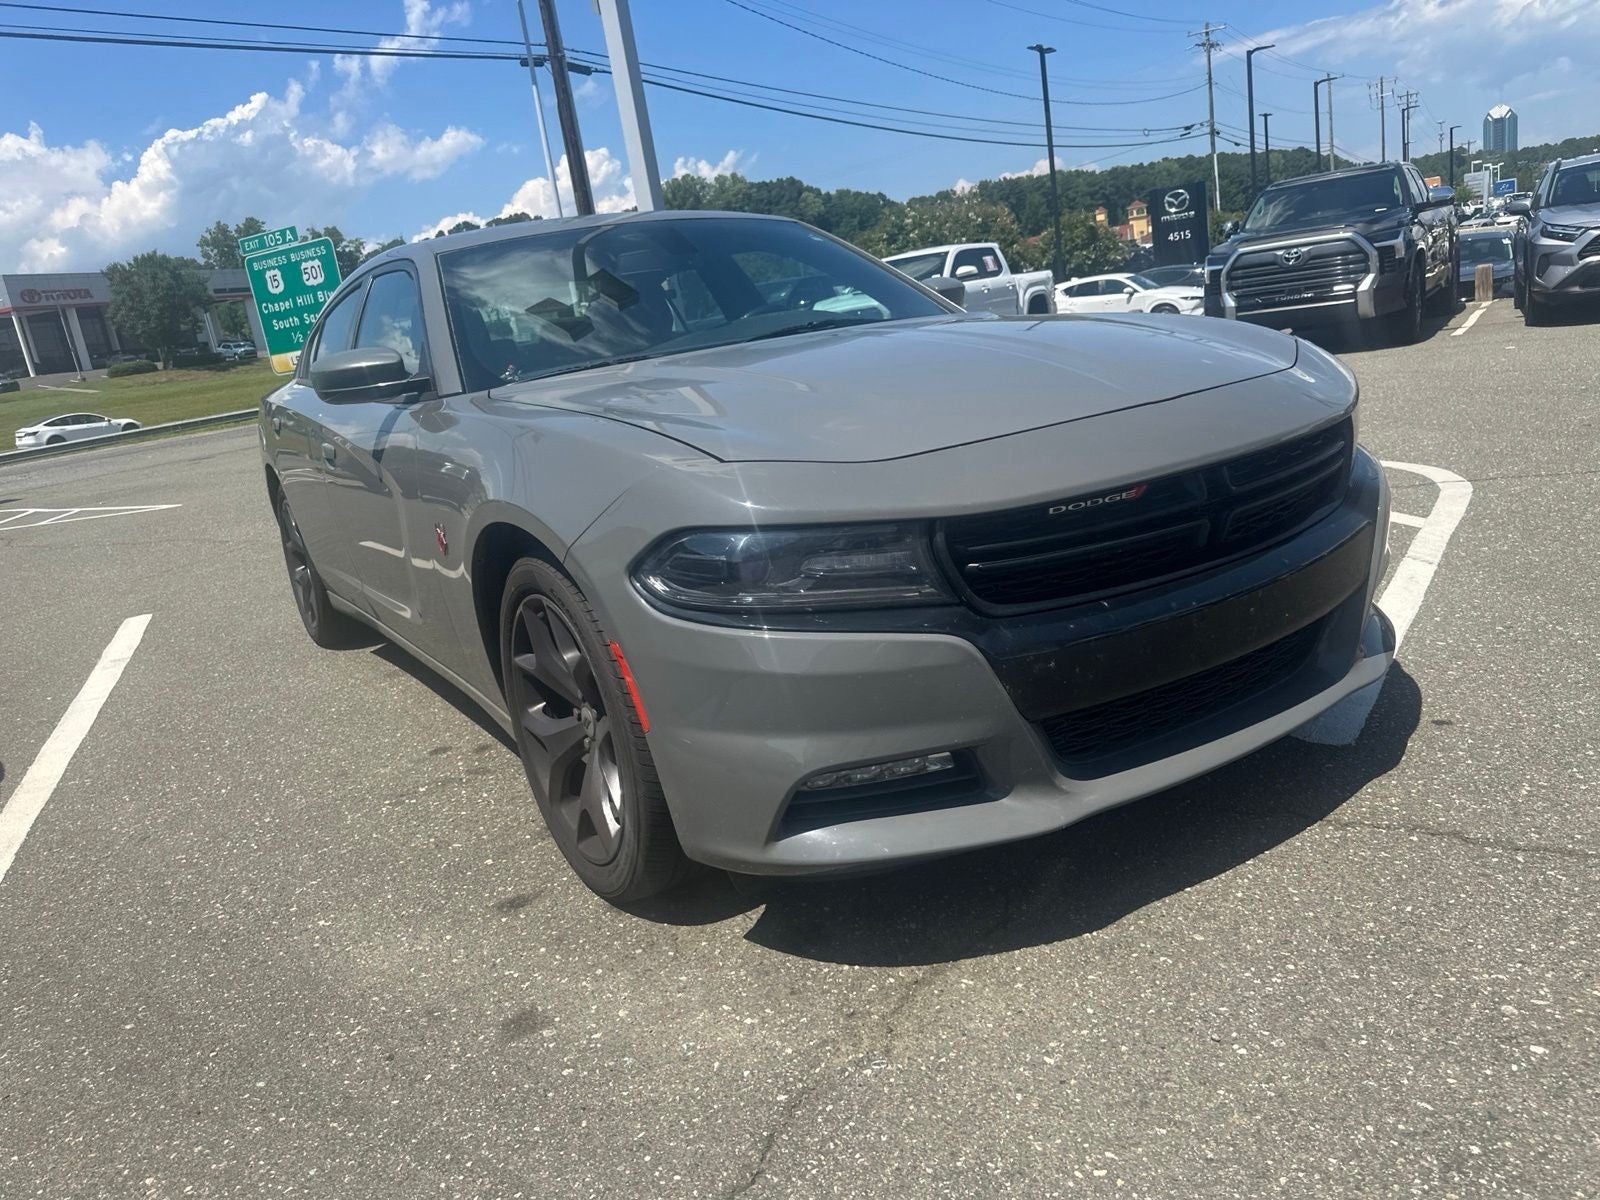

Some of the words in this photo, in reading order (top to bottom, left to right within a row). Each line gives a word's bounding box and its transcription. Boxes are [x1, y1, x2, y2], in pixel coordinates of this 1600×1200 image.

[244, 240, 259, 251] EXIT
[263, 232, 283, 247] 105
[286, 229, 294, 241] A
[1168, 230, 1191, 241] 4515
[252, 256, 287, 271] BUSINESS
[290, 246, 326, 262] BUSINESS
[269, 274, 280, 289] 15
[303, 264, 323, 282] 501
[262, 298, 294, 314] Chapel
[296, 293, 315, 307] Hill
[317, 289, 334, 302] Blv
[272, 315, 300, 331] South
[1049, 489, 1137, 514] DODGE
